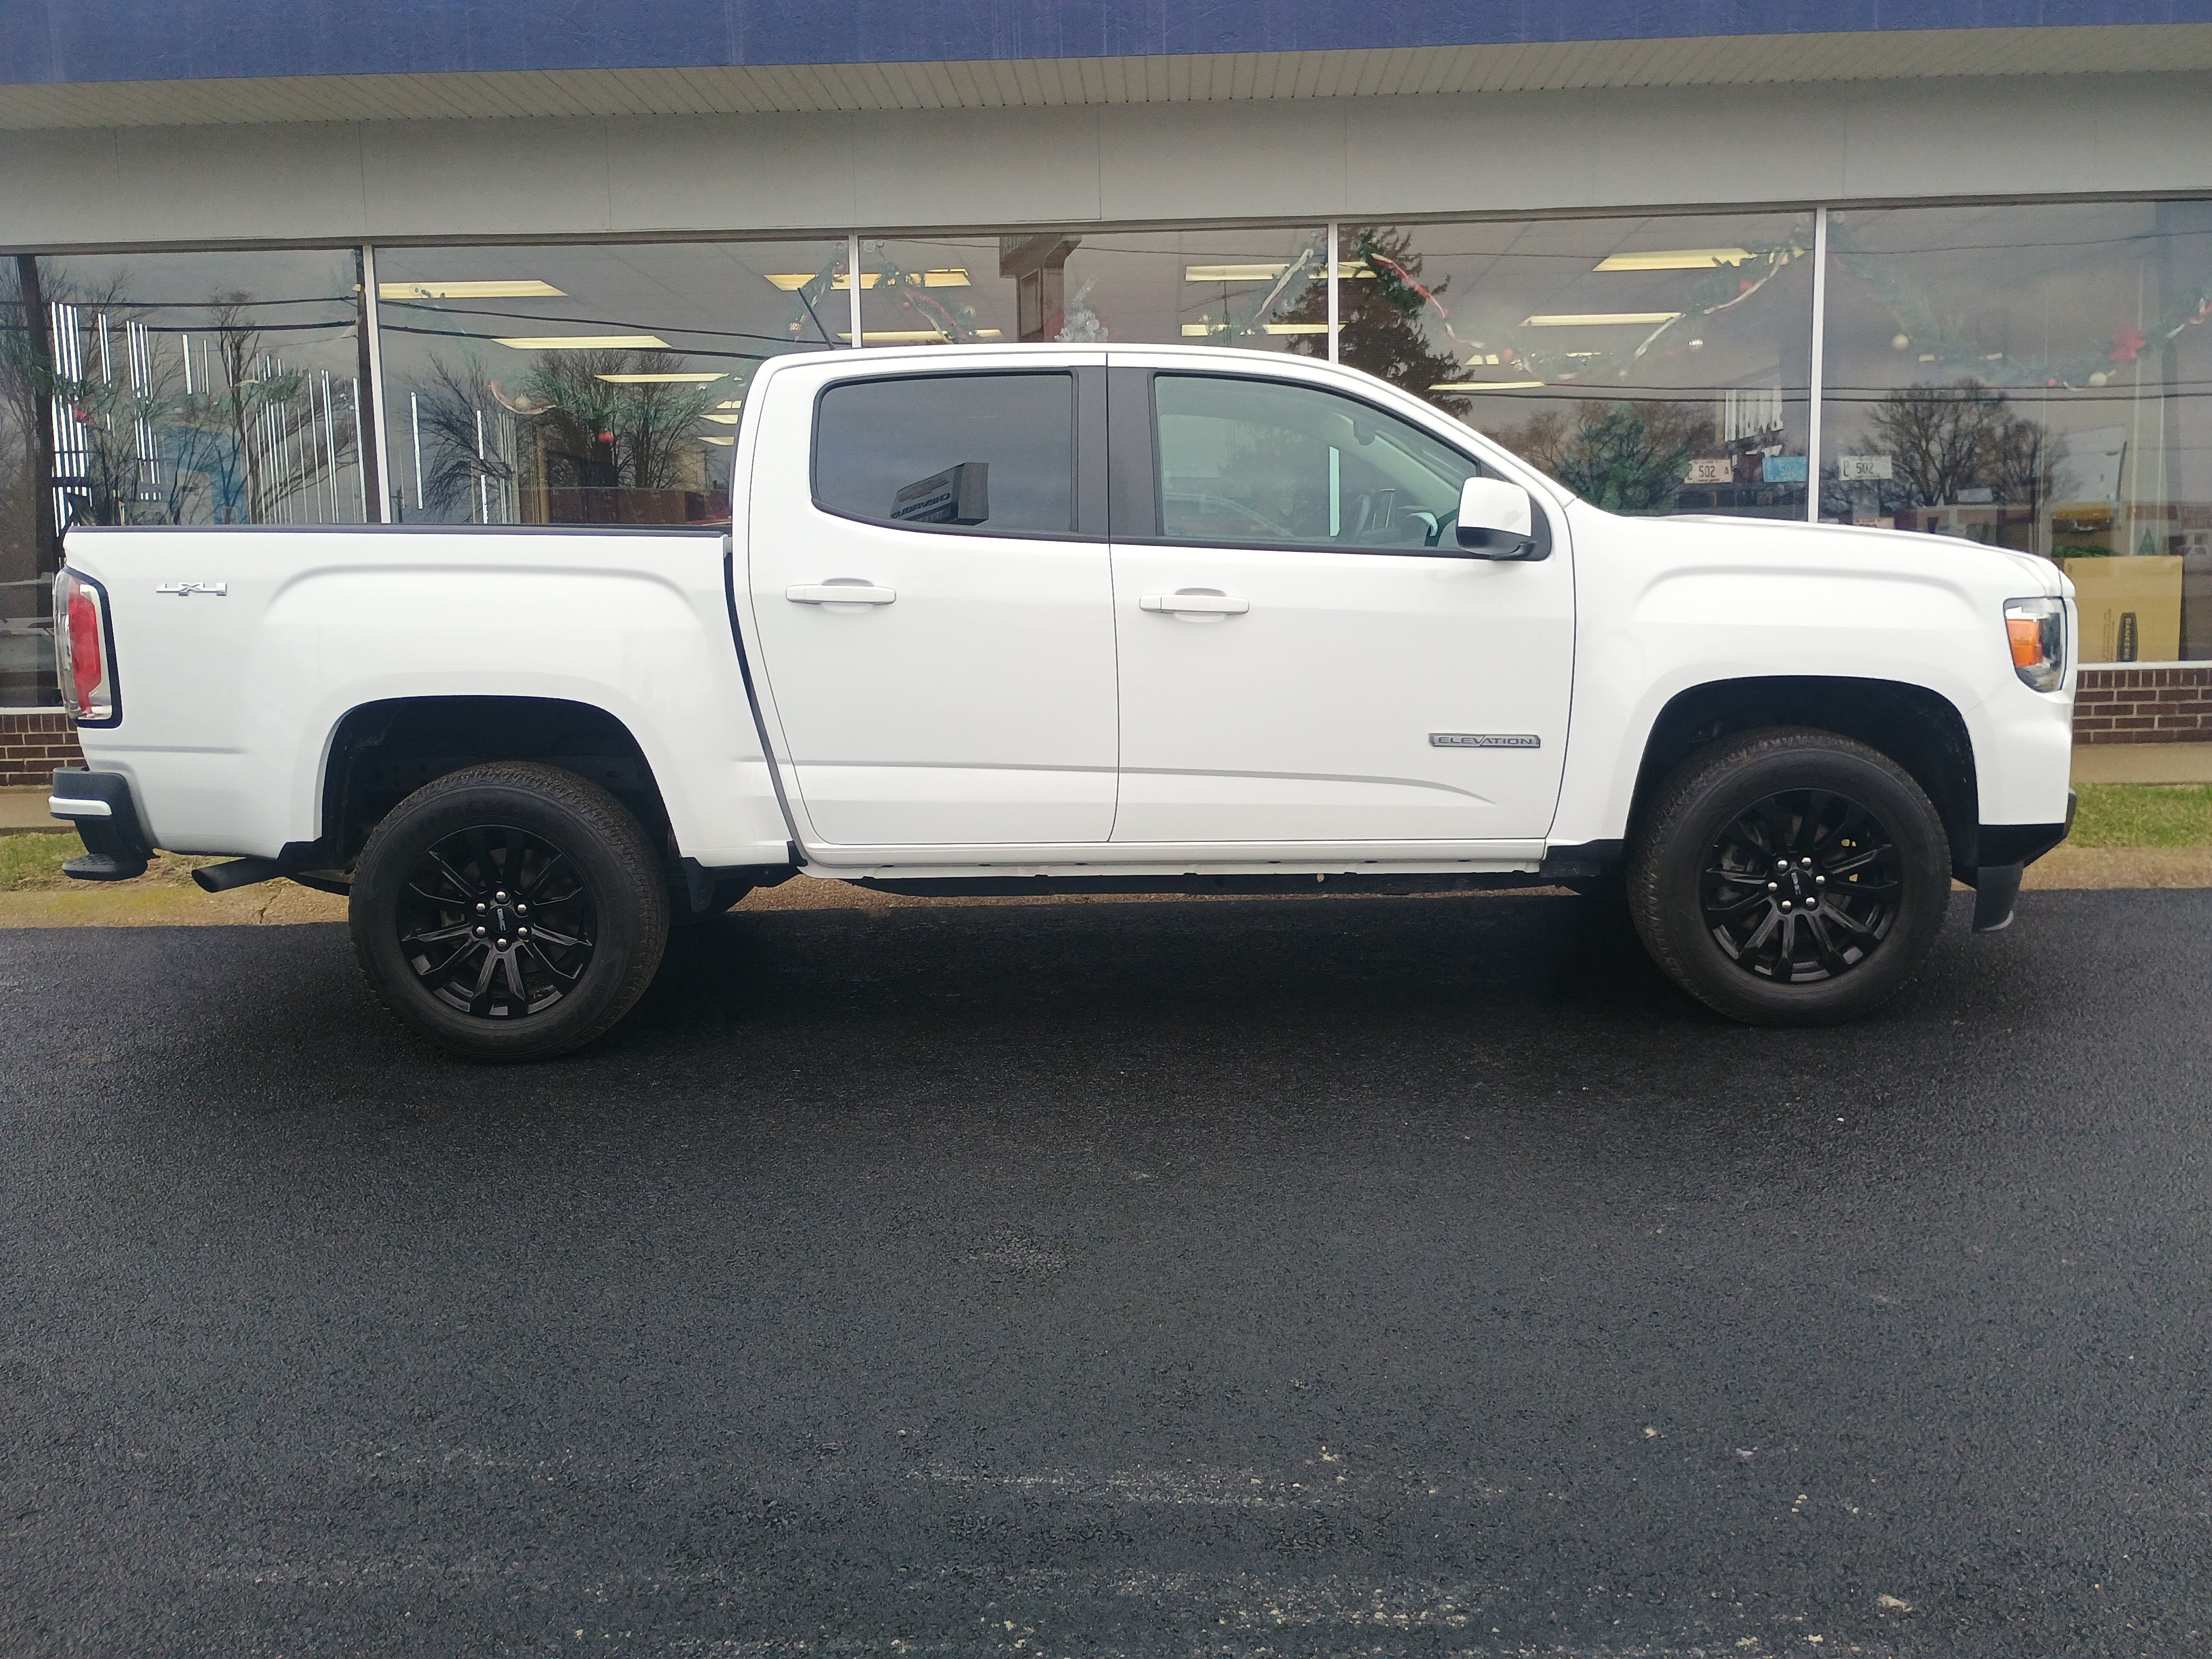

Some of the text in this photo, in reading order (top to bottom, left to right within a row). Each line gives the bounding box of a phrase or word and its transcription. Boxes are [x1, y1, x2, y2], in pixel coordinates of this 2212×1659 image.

[1698, 465, 1716, 477] 502
[1724, 467, 1729, 475] A
[1857, 462, 1874, 474] 502
[1438, 736, 1533, 745] ELEVATION
[497, 908, 506, 931] GMC
